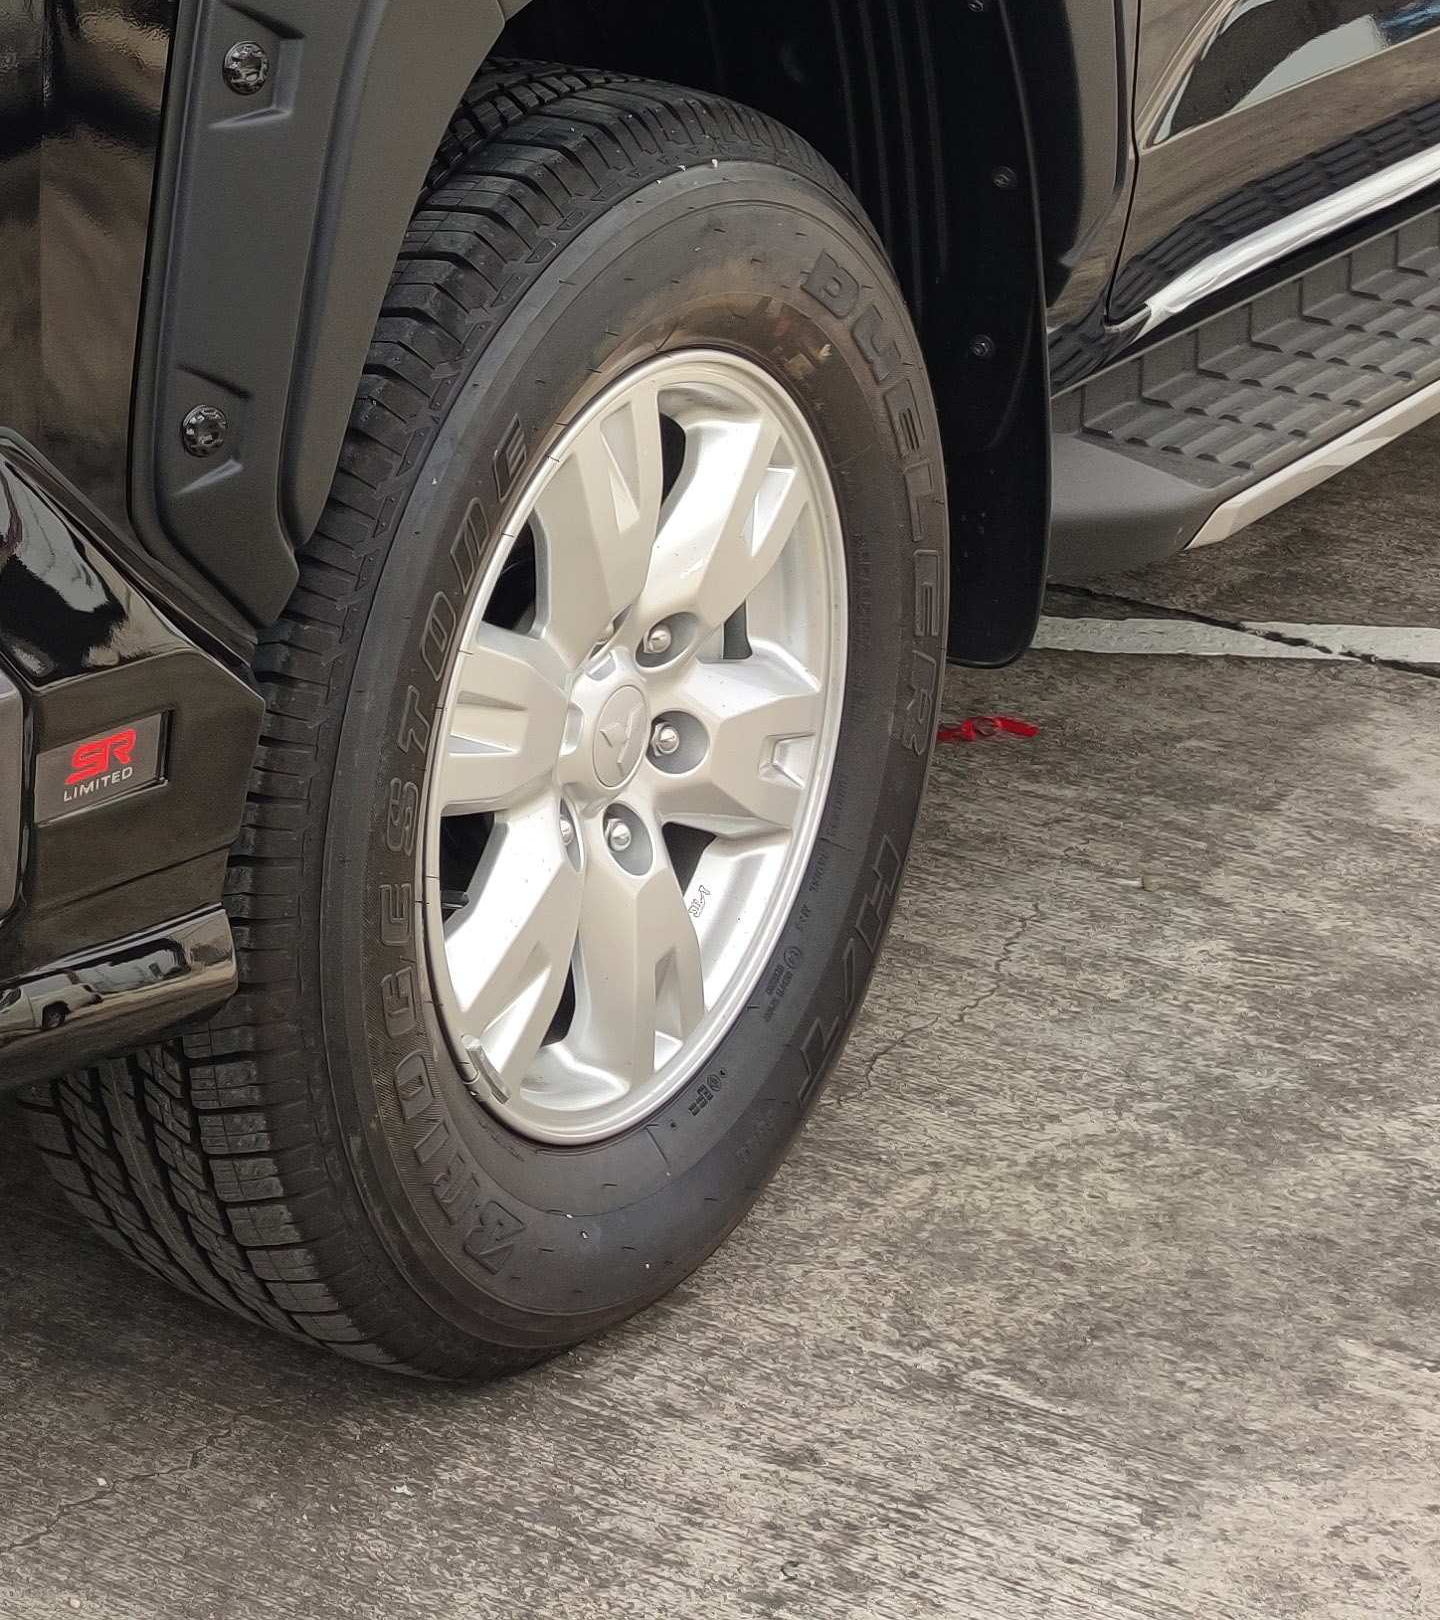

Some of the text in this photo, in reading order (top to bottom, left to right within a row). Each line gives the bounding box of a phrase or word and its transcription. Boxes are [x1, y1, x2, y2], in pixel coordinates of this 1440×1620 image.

[801, 248, 941, 757] DUELER
[63, 728, 137, 802] SR LIMITED
[378, 412, 527, 1274] BRIDGESTONE
